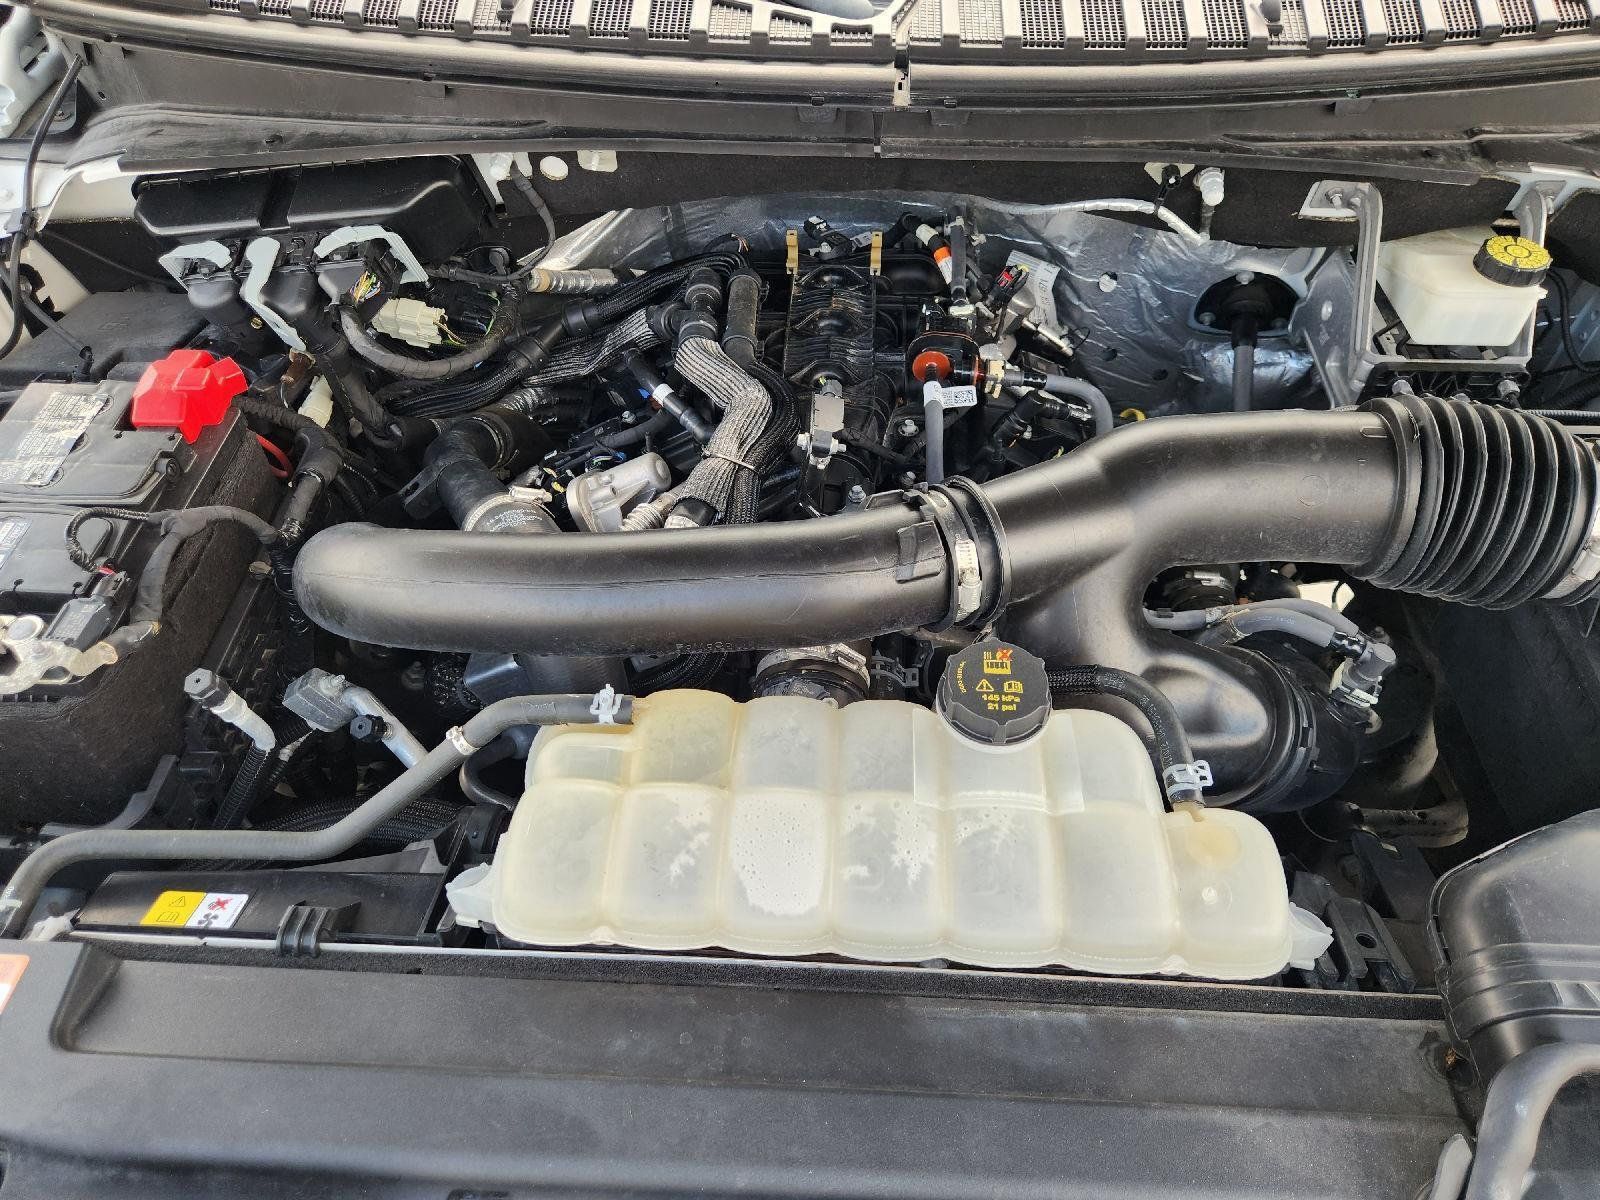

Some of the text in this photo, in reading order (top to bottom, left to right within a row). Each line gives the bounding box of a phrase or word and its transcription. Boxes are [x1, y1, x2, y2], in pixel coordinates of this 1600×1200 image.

[981, 694, 1020, 702] 145 kPa
[987, 702, 998, 710] 21
